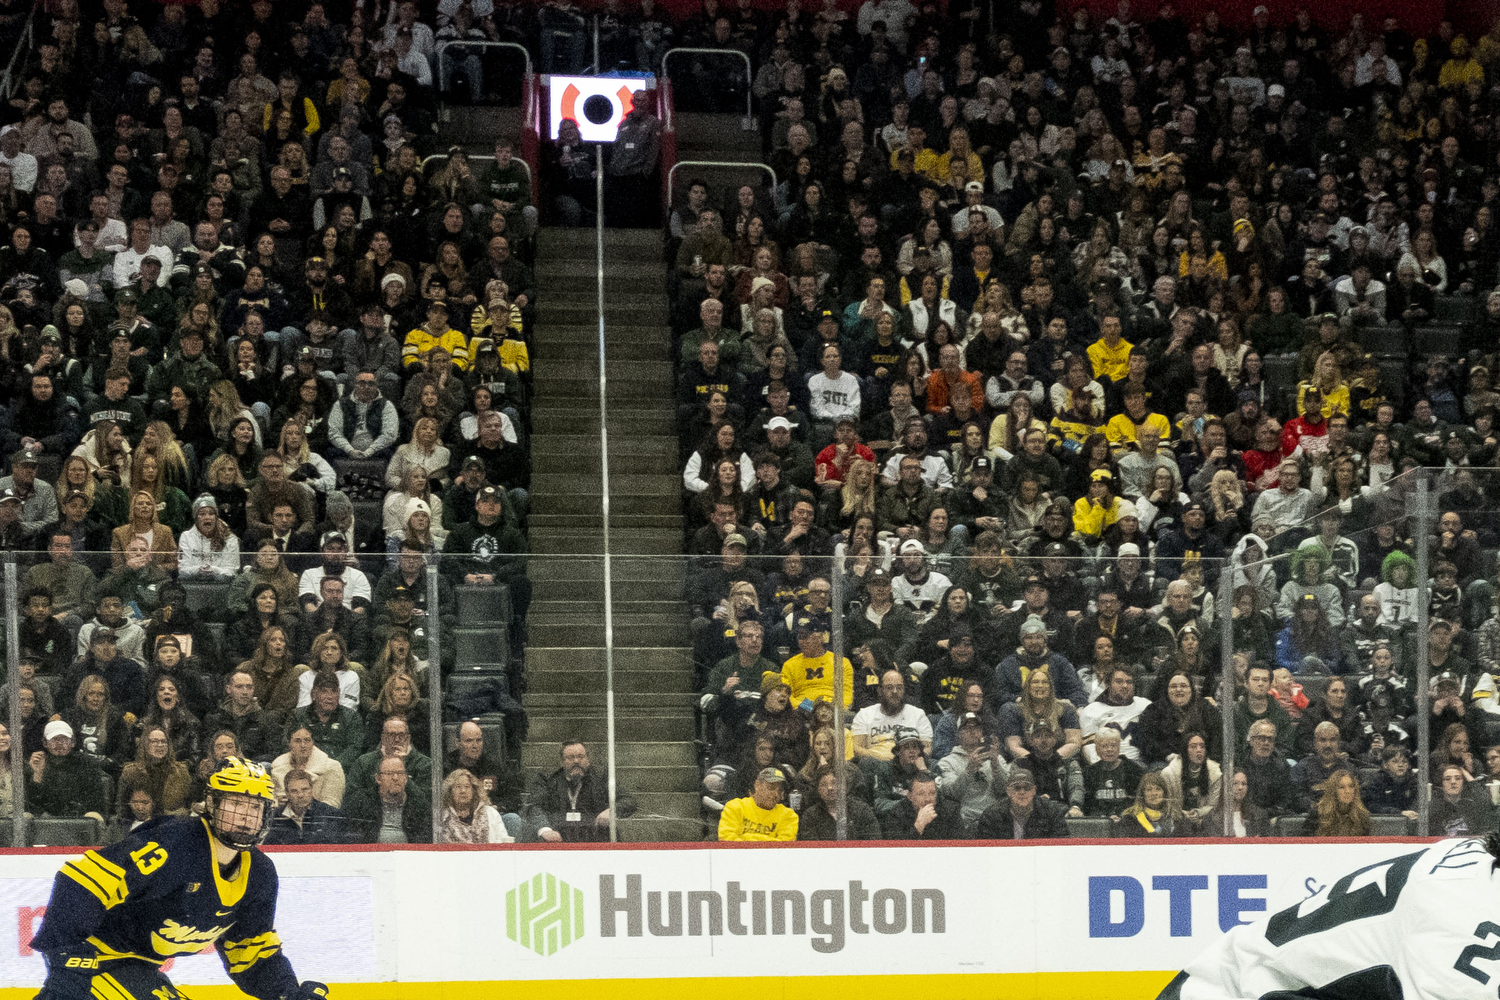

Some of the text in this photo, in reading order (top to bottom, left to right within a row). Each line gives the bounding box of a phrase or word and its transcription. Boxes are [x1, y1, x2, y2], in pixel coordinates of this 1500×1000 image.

[821, 391, 849, 406] STATE
[805, 667, 824, 680] M
[129, 841, 169, 876] 13
[599, 873, 947, 954] Huntington
[1088, 874, 1268, 938] DTE
[65, 957, 99, 970] BAU
